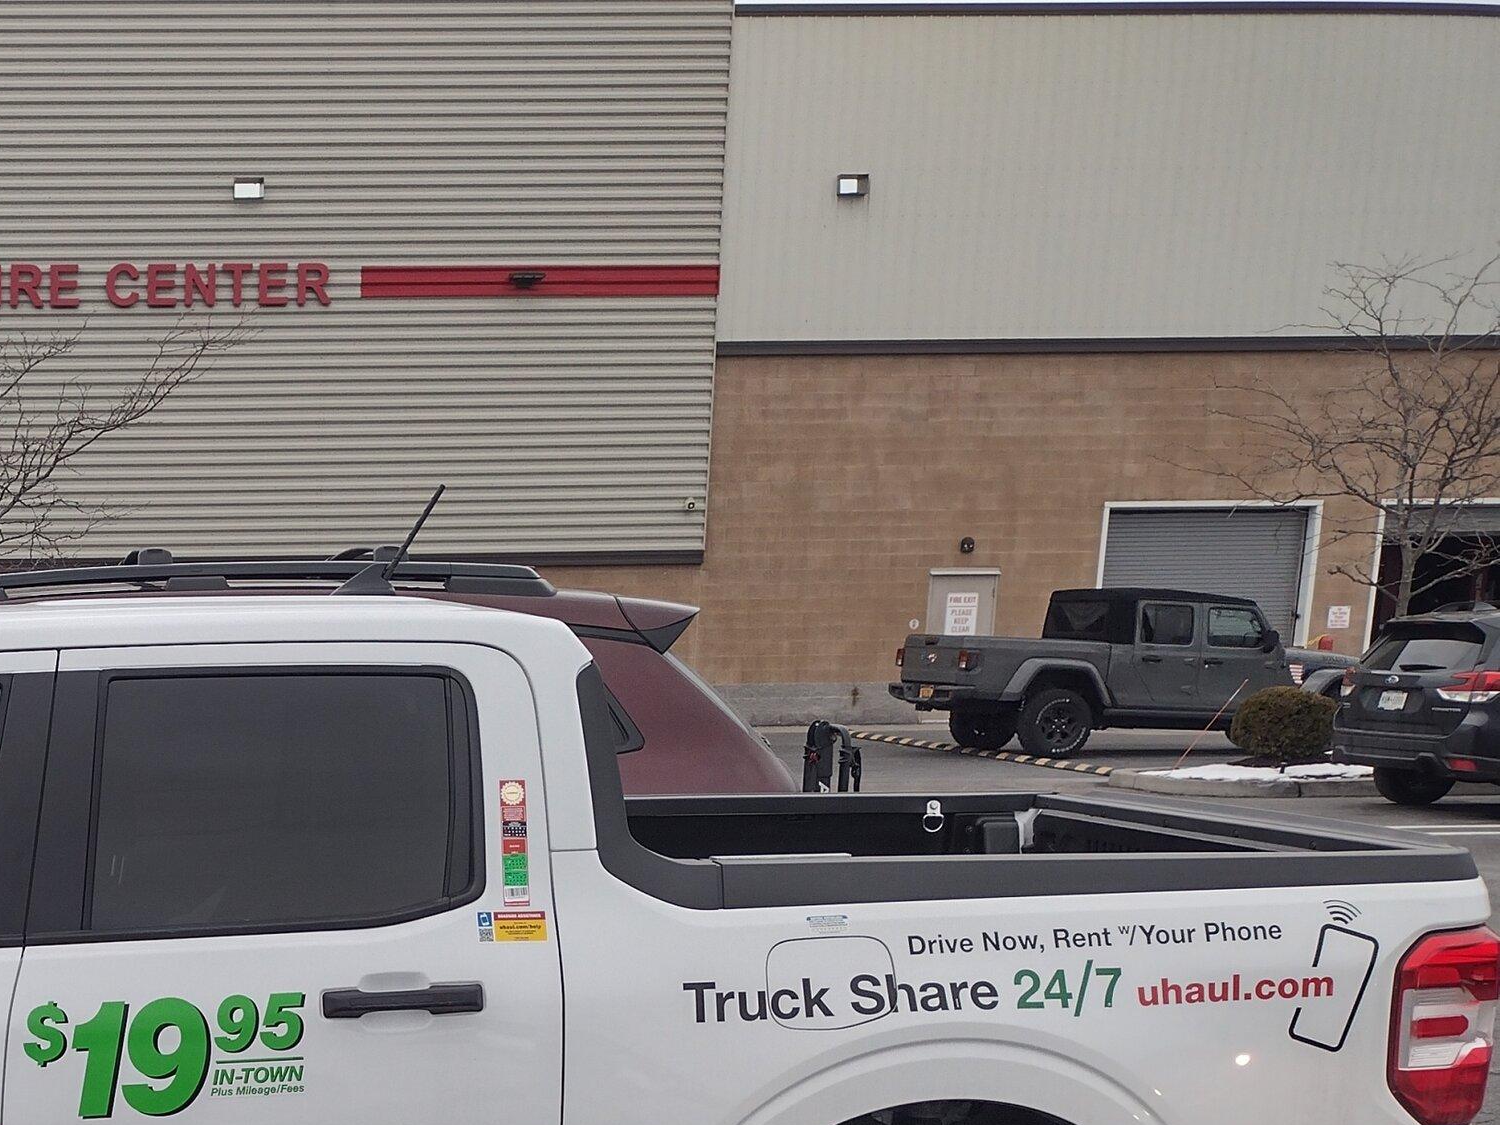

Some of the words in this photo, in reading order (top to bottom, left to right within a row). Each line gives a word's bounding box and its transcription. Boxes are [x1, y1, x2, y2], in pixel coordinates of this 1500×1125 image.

[105, 262, 332, 308] CENTER
[908, 934, 974, 955] Drive
[982, 931, 1045, 953] Now,
[1053, 927, 1112, 948] Rent
[1204, 921, 1283, 942] Phone
[682, 978, 835, 1023] Truck
[849, 973, 999, 1015] Share
[1013, 959, 1122, 1017] 24/7
[1137, 974, 1334, 1006] uhaul.com
[210, 1087, 234, 1097] Plus
[235, 1084, 305, 1096] Mileage/Fees
[212, 1065, 304, 1086] IN-TOWN
